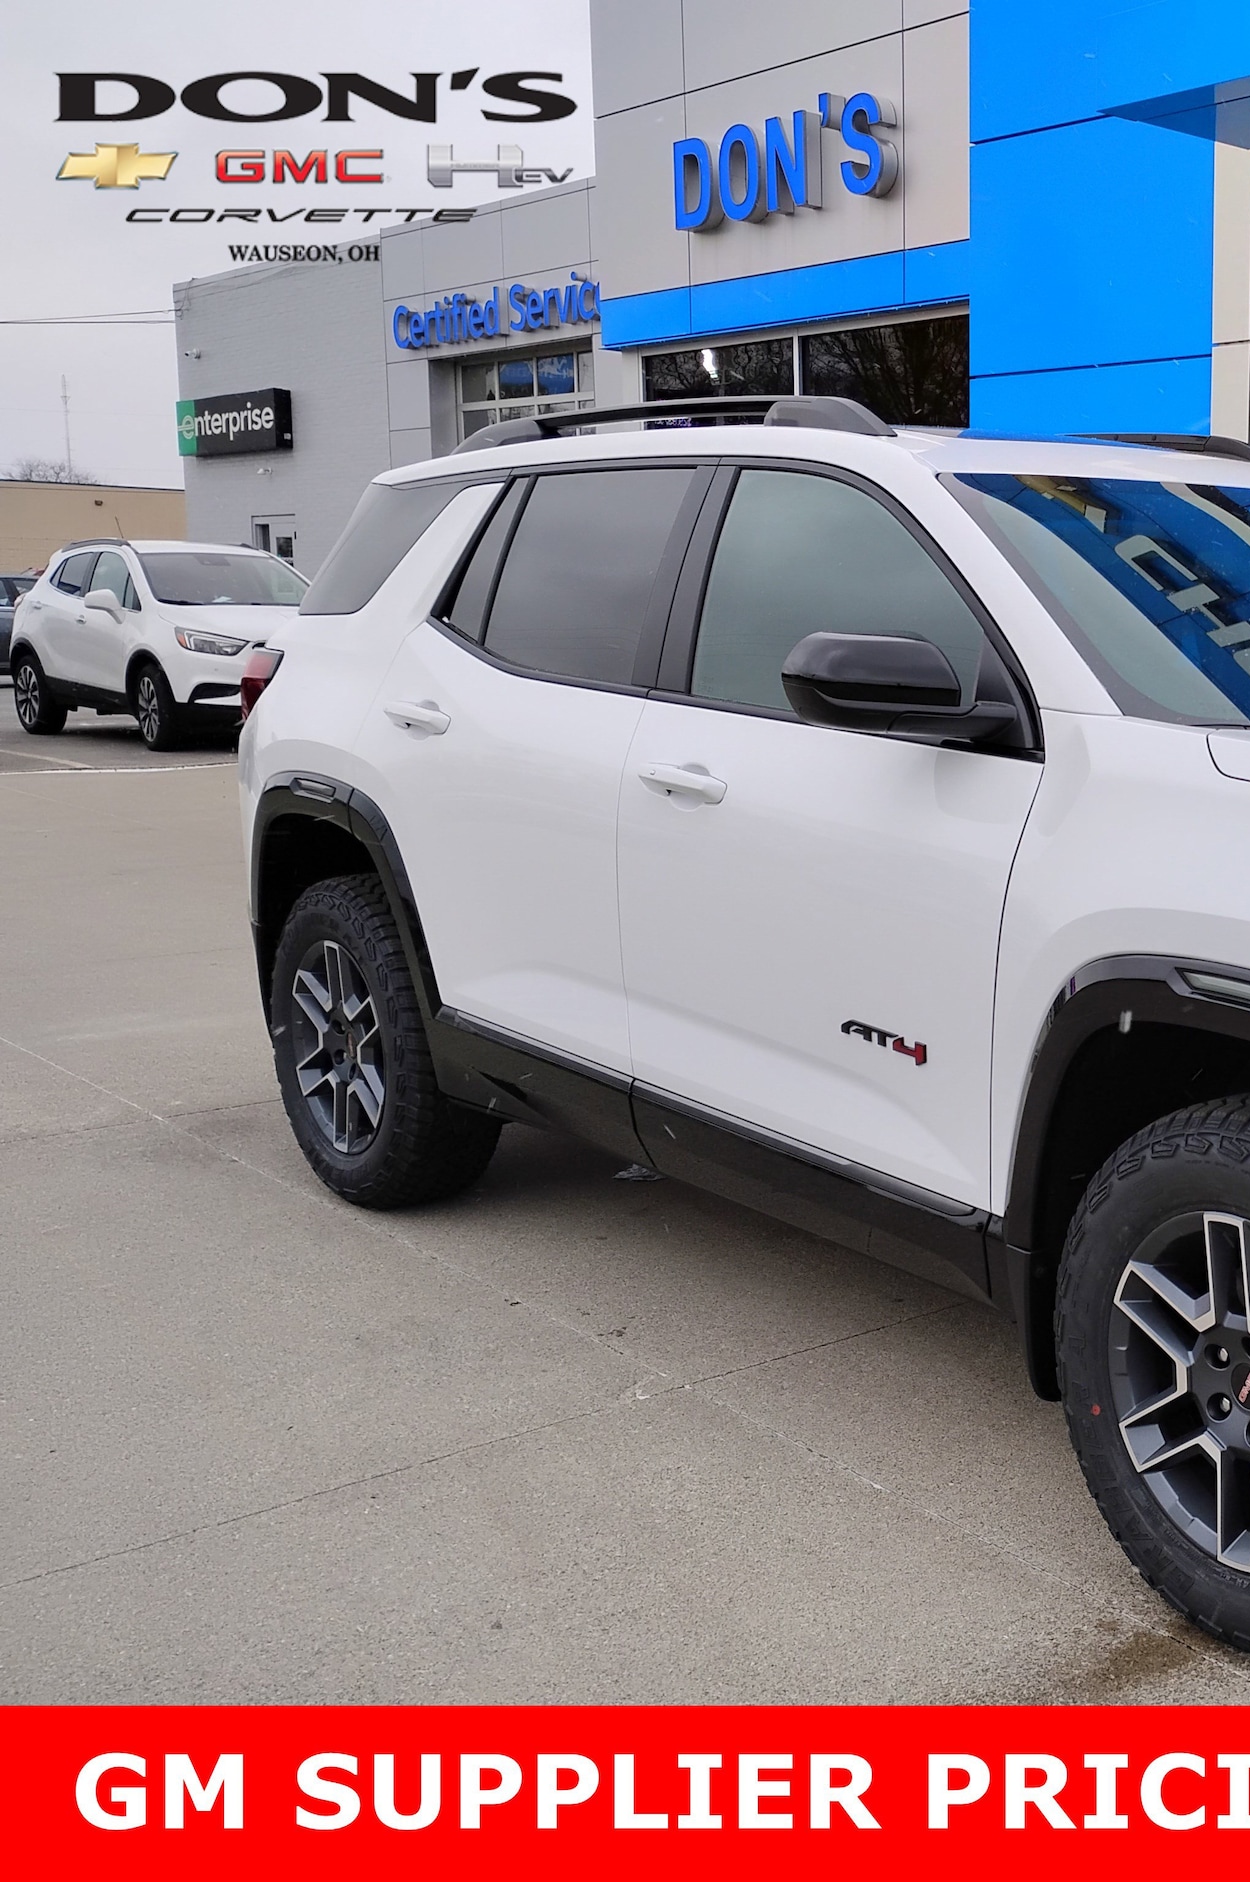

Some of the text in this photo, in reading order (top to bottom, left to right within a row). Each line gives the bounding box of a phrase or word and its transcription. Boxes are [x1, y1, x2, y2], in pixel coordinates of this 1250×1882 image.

[673, 92, 896, 232] DON'S
[393, 271, 600, 348] Certified Servic
[178, 401, 274, 441] enterprise
[841, 1019, 927, 1066] AT4
